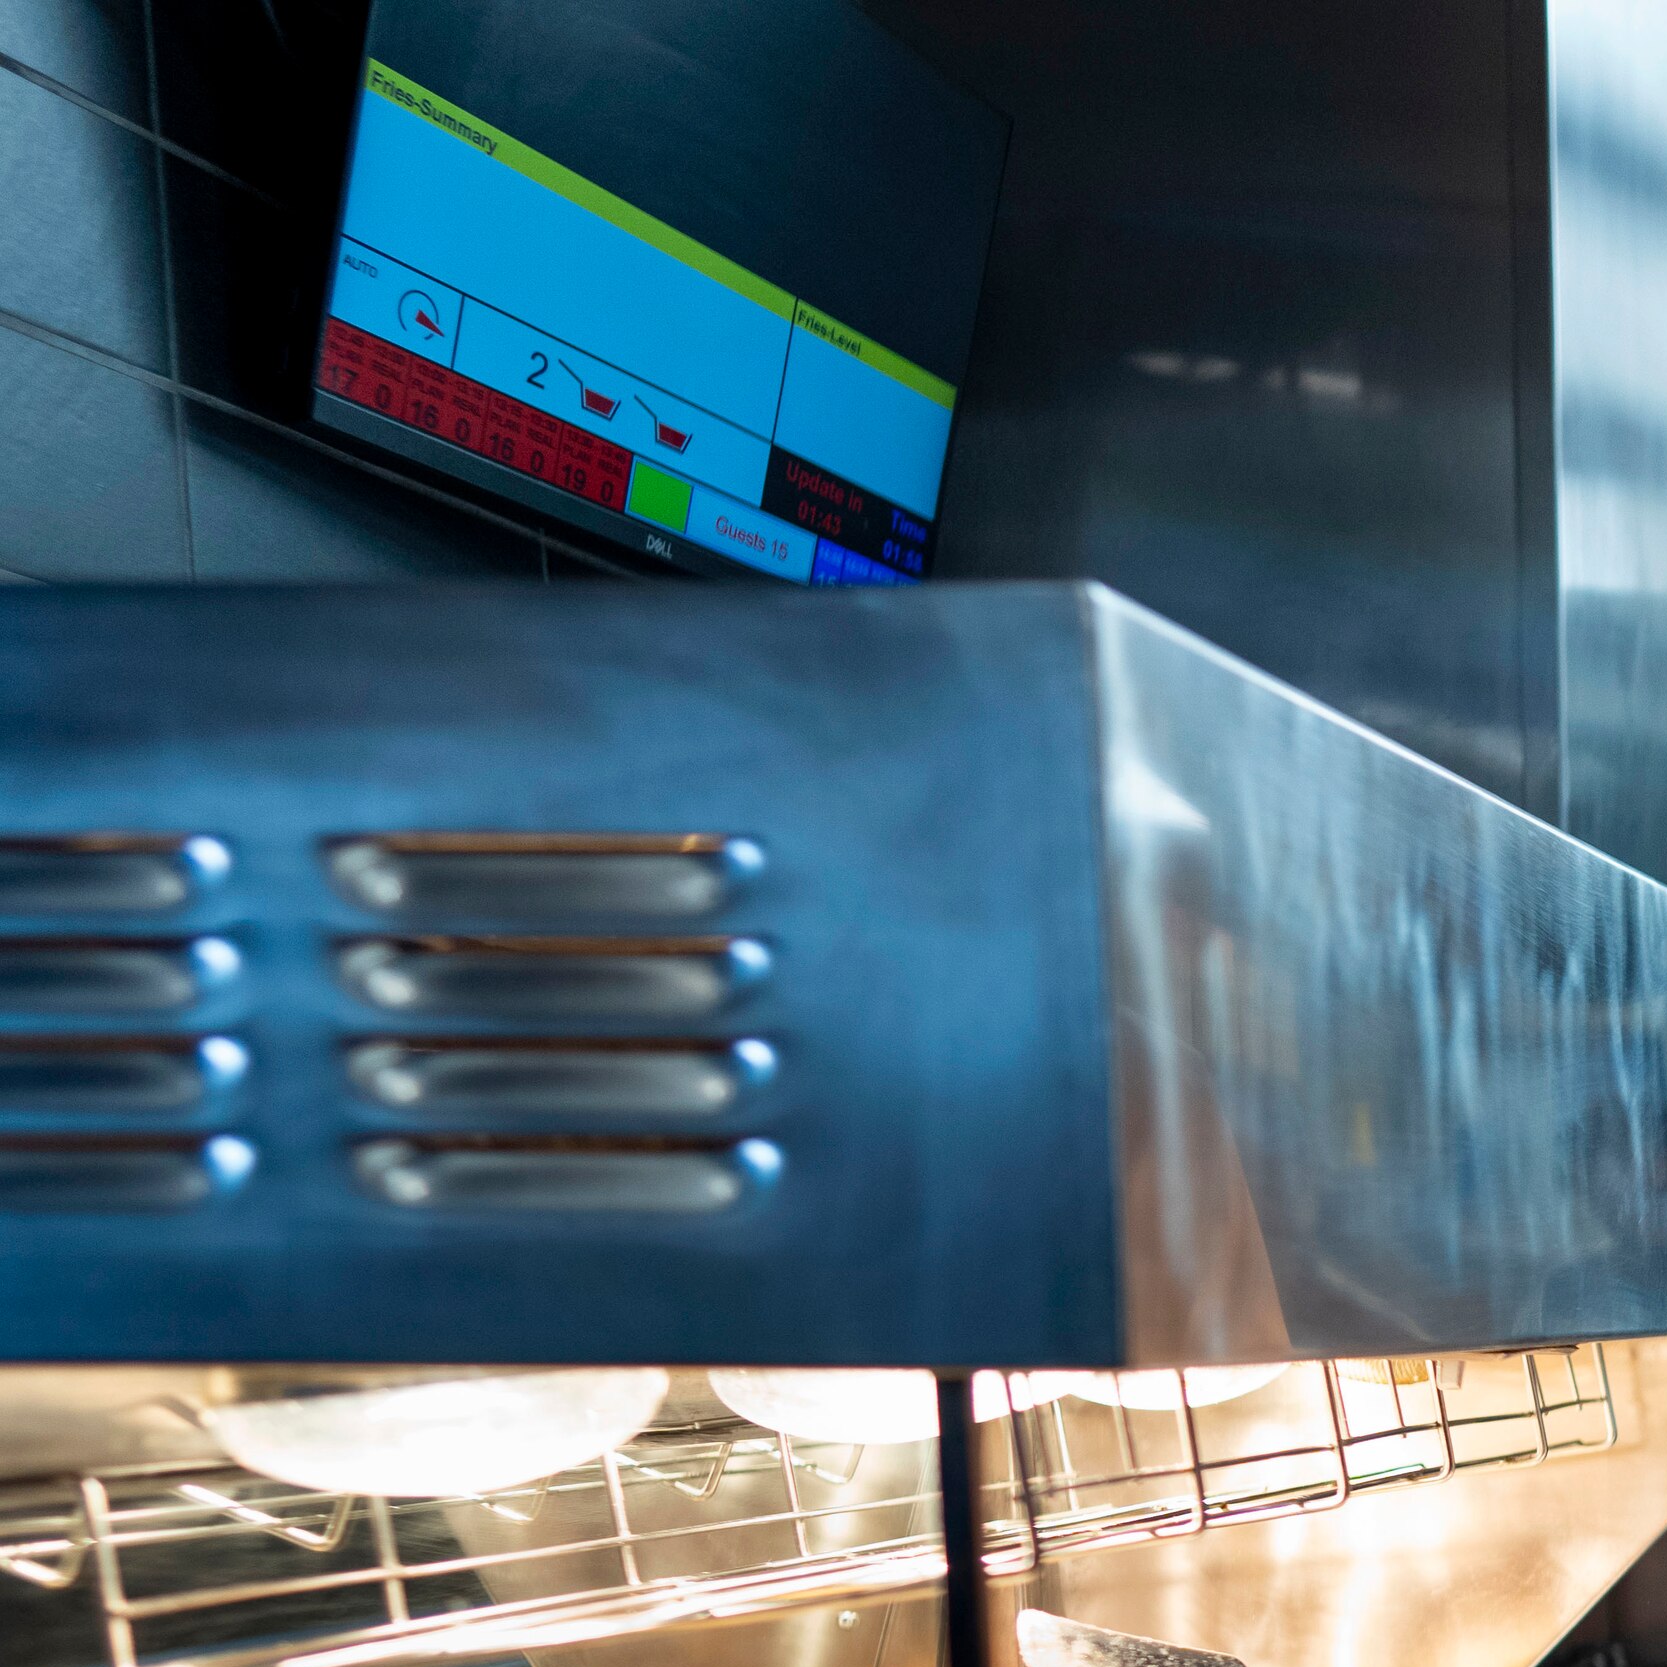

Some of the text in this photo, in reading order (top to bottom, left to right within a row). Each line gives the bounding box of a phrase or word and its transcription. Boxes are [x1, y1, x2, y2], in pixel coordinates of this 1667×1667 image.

[370, 69, 498, 156] Fries-Summary
[343, 254, 379, 279] AUTO
[526, 351, 549, 390] 2
[374, 383, 392, 410] 0
[455, 417, 471, 442] 0
[530, 450, 544, 474] 0
[563, 464, 614, 503] 19 0
[786, 460, 845, 506] Update
[645, 534, 672, 559] DELL
[715, 516, 765, 552] Guests
